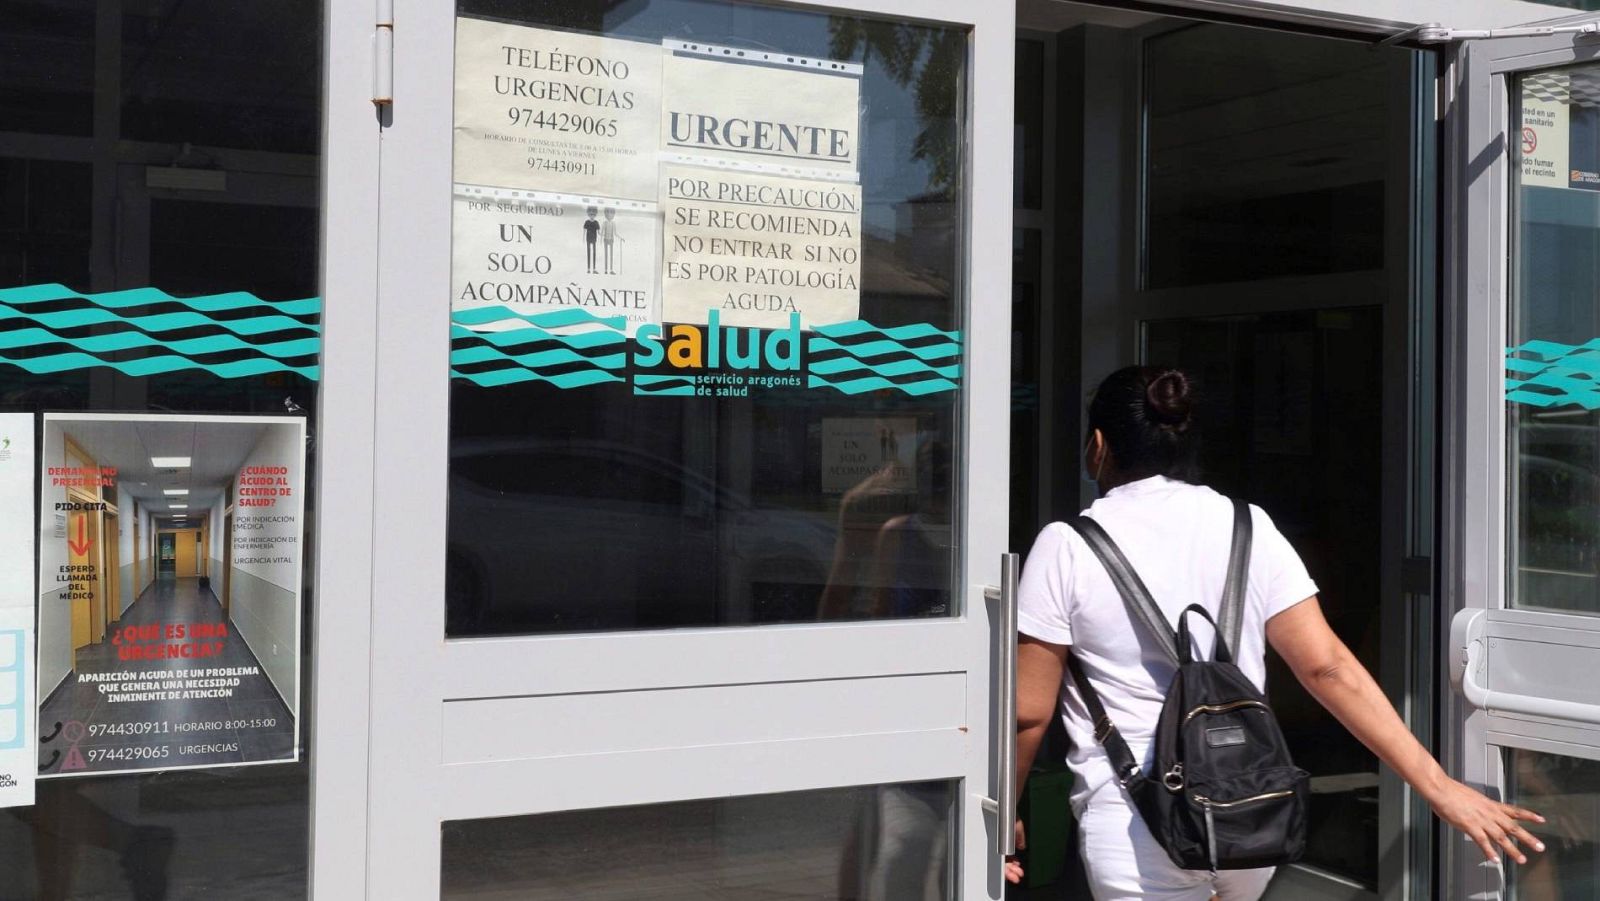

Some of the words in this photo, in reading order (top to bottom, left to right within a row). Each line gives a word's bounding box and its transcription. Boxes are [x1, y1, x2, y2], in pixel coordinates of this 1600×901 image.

[502, 46, 629, 80] TELÉFONO
[494, 75, 634, 110] URGENCIAS
[1522, 107, 1535, 116] sted
[509, 106, 618, 137] 974429065
[1525, 118, 1554, 127] sanitario
[484, 133, 518, 143] HORARIO
[669, 111, 849, 158] URGENTE
[528, 146, 538, 154] DE
[539, 147, 560, 156] LUNES
[527, 157, 595, 176] 974430911
[1534, 158, 1554, 168] fumar
[1532, 168, 1556, 178] recinto
[668, 177, 711, 199] POR
[718, 182, 860, 212] PRECAUCIÓN.
[468, 200, 490, 212] POR
[497, 202, 564, 217] SEGURIDAD
[674, 207, 700, 226] SE
[708, 209, 852, 238] RECOMIENDA
[498, 223, 533, 243] UN
[673, 235, 704, 254] NO
[710, 238, 793, 260] ENTRAR
[804, 245, 821, 262] SI
[828, 247, 857, 264] NO
[487, 252, 552, 275] SOLO
[667, 261, 691, 280] ES
[699, 263, 738, 283] POR
[745, 267, 857, 290] PATOLOGÍA
[460, 281, 646, 309] ACOMPAÑANTE
[722, 292, 802, 313] AGUDA.
[633, 308, 801, 371] salud
[697, 373, 744, 385] servicio
[748, 375, 801, 388] aragonés
[697, 386, 712, 397] de
[715, 386, 748, 397] salud
[240, 477, 274, 485] ACUDO
[276, 477, 288, 485] AL
[239, 488, 277, 496] CENTRO
[279, 488, 292, 496] DE
[55, 502, 81, 511] PIDO
[84, 502, 107, 511] CITA
[239, 499, 276, 507] SALUD?
[253, 515, 295, 523] INDICACIÓN
[59, 565, 95, 573] ESPERO
[59, 591, 94, 600] MÉDICO
[112, 622, 160, 645] ¿QUÉ
[165, 625, 185, 640] ES
[189, 624, 228, 639] UNA
[118, 642, 224, 661] URGENCIA?
[78, 670, 136, 683] APARICIÓN
[139, 670, 174, 681] AGUDA
[176, 669, 189, 679] DE
[190, 669, 204, 678] UN
[206, 666, 259, 677] PROBLEMA
[98, 683, 119, 694] QUE
[121, 682, 160, 692] GENERA
[162, 680, 183, 690] UNA
[185, 678, 240, 689] NECESIDAD
[107, 692, 167, 703] INMINENTE
[168, 690, 181, 700] DE
[182, 687, 233, 699] ATENCIÓN
[88, 721, 169, 737] 974430911
[174, 721, 223, 733] HORARIO
[225, 718, 277, 730] 8:00-15:00
[88, 745, 169, 762] 974429065
[179, 743, 238, 755] URGENCIAS
